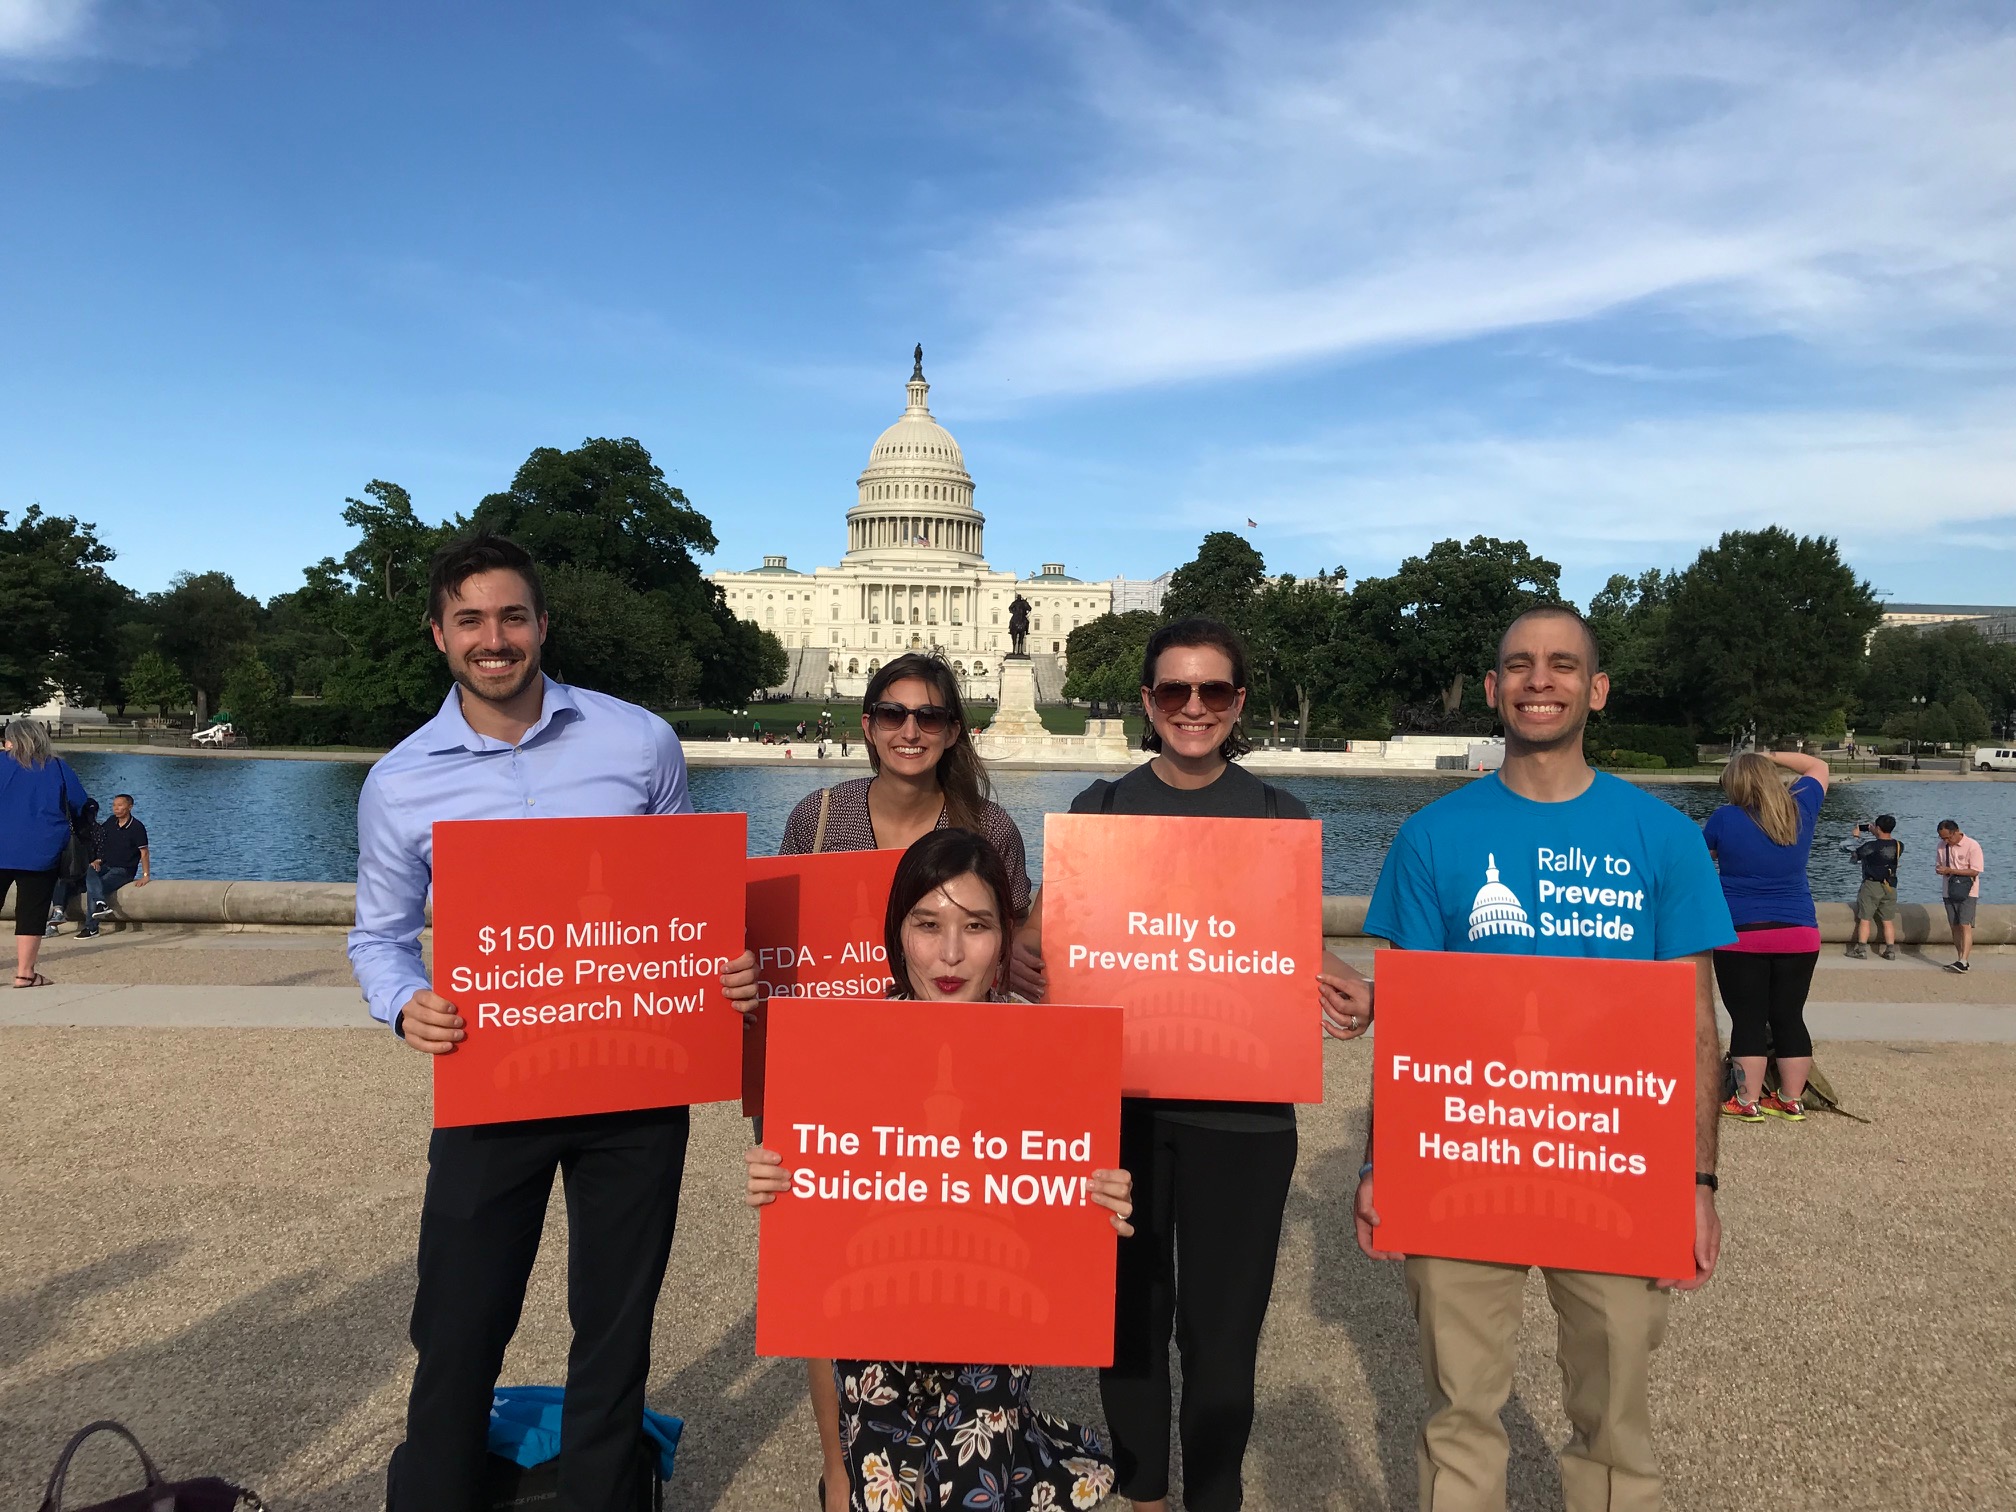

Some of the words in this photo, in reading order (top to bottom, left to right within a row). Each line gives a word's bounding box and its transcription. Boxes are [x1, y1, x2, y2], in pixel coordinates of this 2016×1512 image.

[1538, 846, 1597, 878] Rally
[1603, 854, 1631, 876] to
[1538, 879, 1645, 911] Prevent
[478, 924, 555, 956] $150
[566, 920, 658, 948] Million
[668, 917, 708, 942] for
[1128, 911, 1199, 943] Rally
[1207, 914, 1236, 938] to
[1540, 911, 1635, 942] Suicide
[450, 962, 564, 993] Suicide
[575, 952, 729, 985] Prevention
[758, 945, 816, 970] FDA
[840, 941, 887, 965] Allo
[1069, 944, 1179, 972] Prevent
[1187, 947, 1295, 975] Suicide
[478, 994, 622, 1029] Research
[633, 988, 704, 1017] Now!
[1393, 1055, 1473, 1086] Fund
[1484, 1061, 1677, 1105] Community
[1444, 1096, 1621, 1134] Behavioral
[792, 1123, 860, 1156] The
[871, 1125, 961, 1159] Time
[972, 1130, 1008, 1160] to
[1021, 1130, 1091, 1162] End
[1419, 1132, 1521, 1165] Health
[1532, 1140, 1647, 1175] Clinics
[792, 1167, 928, 1203] Suicide
[941, 1172, 971, 1204] is
[984, 1173, 1088, 1206] NOW!
